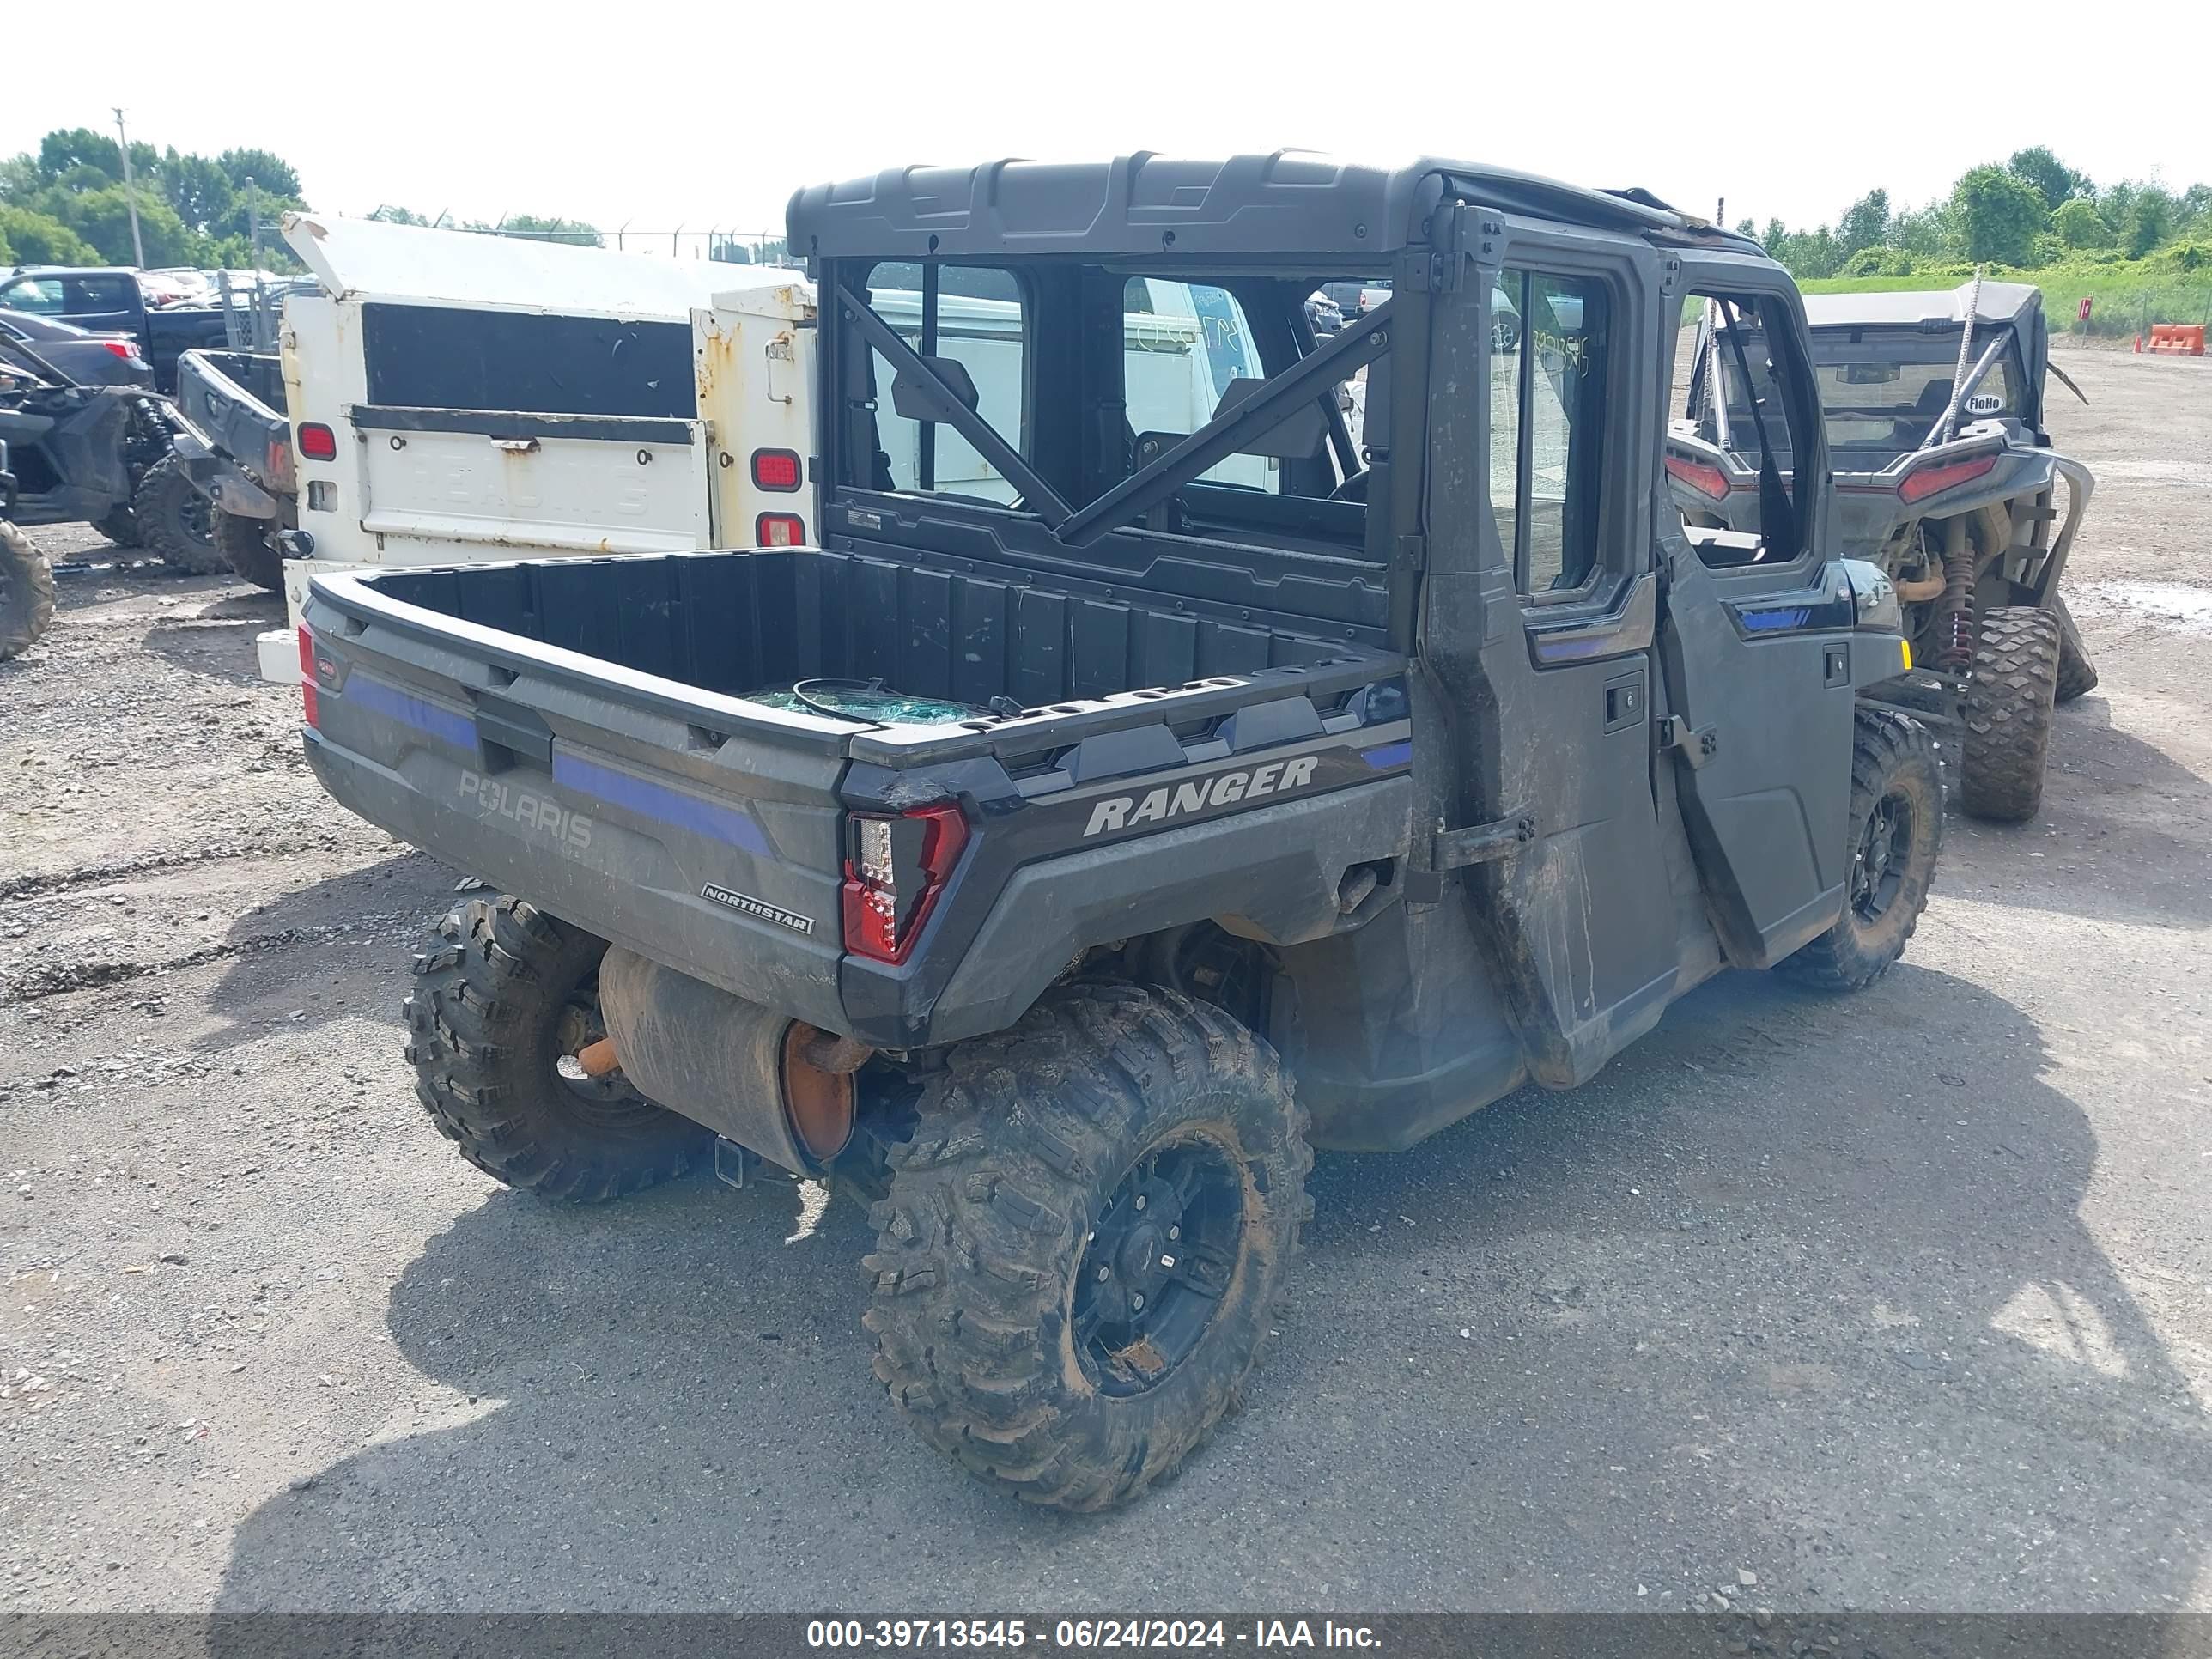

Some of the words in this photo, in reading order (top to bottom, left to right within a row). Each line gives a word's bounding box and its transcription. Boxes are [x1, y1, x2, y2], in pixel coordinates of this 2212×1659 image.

[1969, 397, 2000, 410] FloHo
[458, 769, 592, 849] POLARIS
[1083, 756, 1319, 838] RANGER
[705, 887, 807, 930] NORTHSTAR
